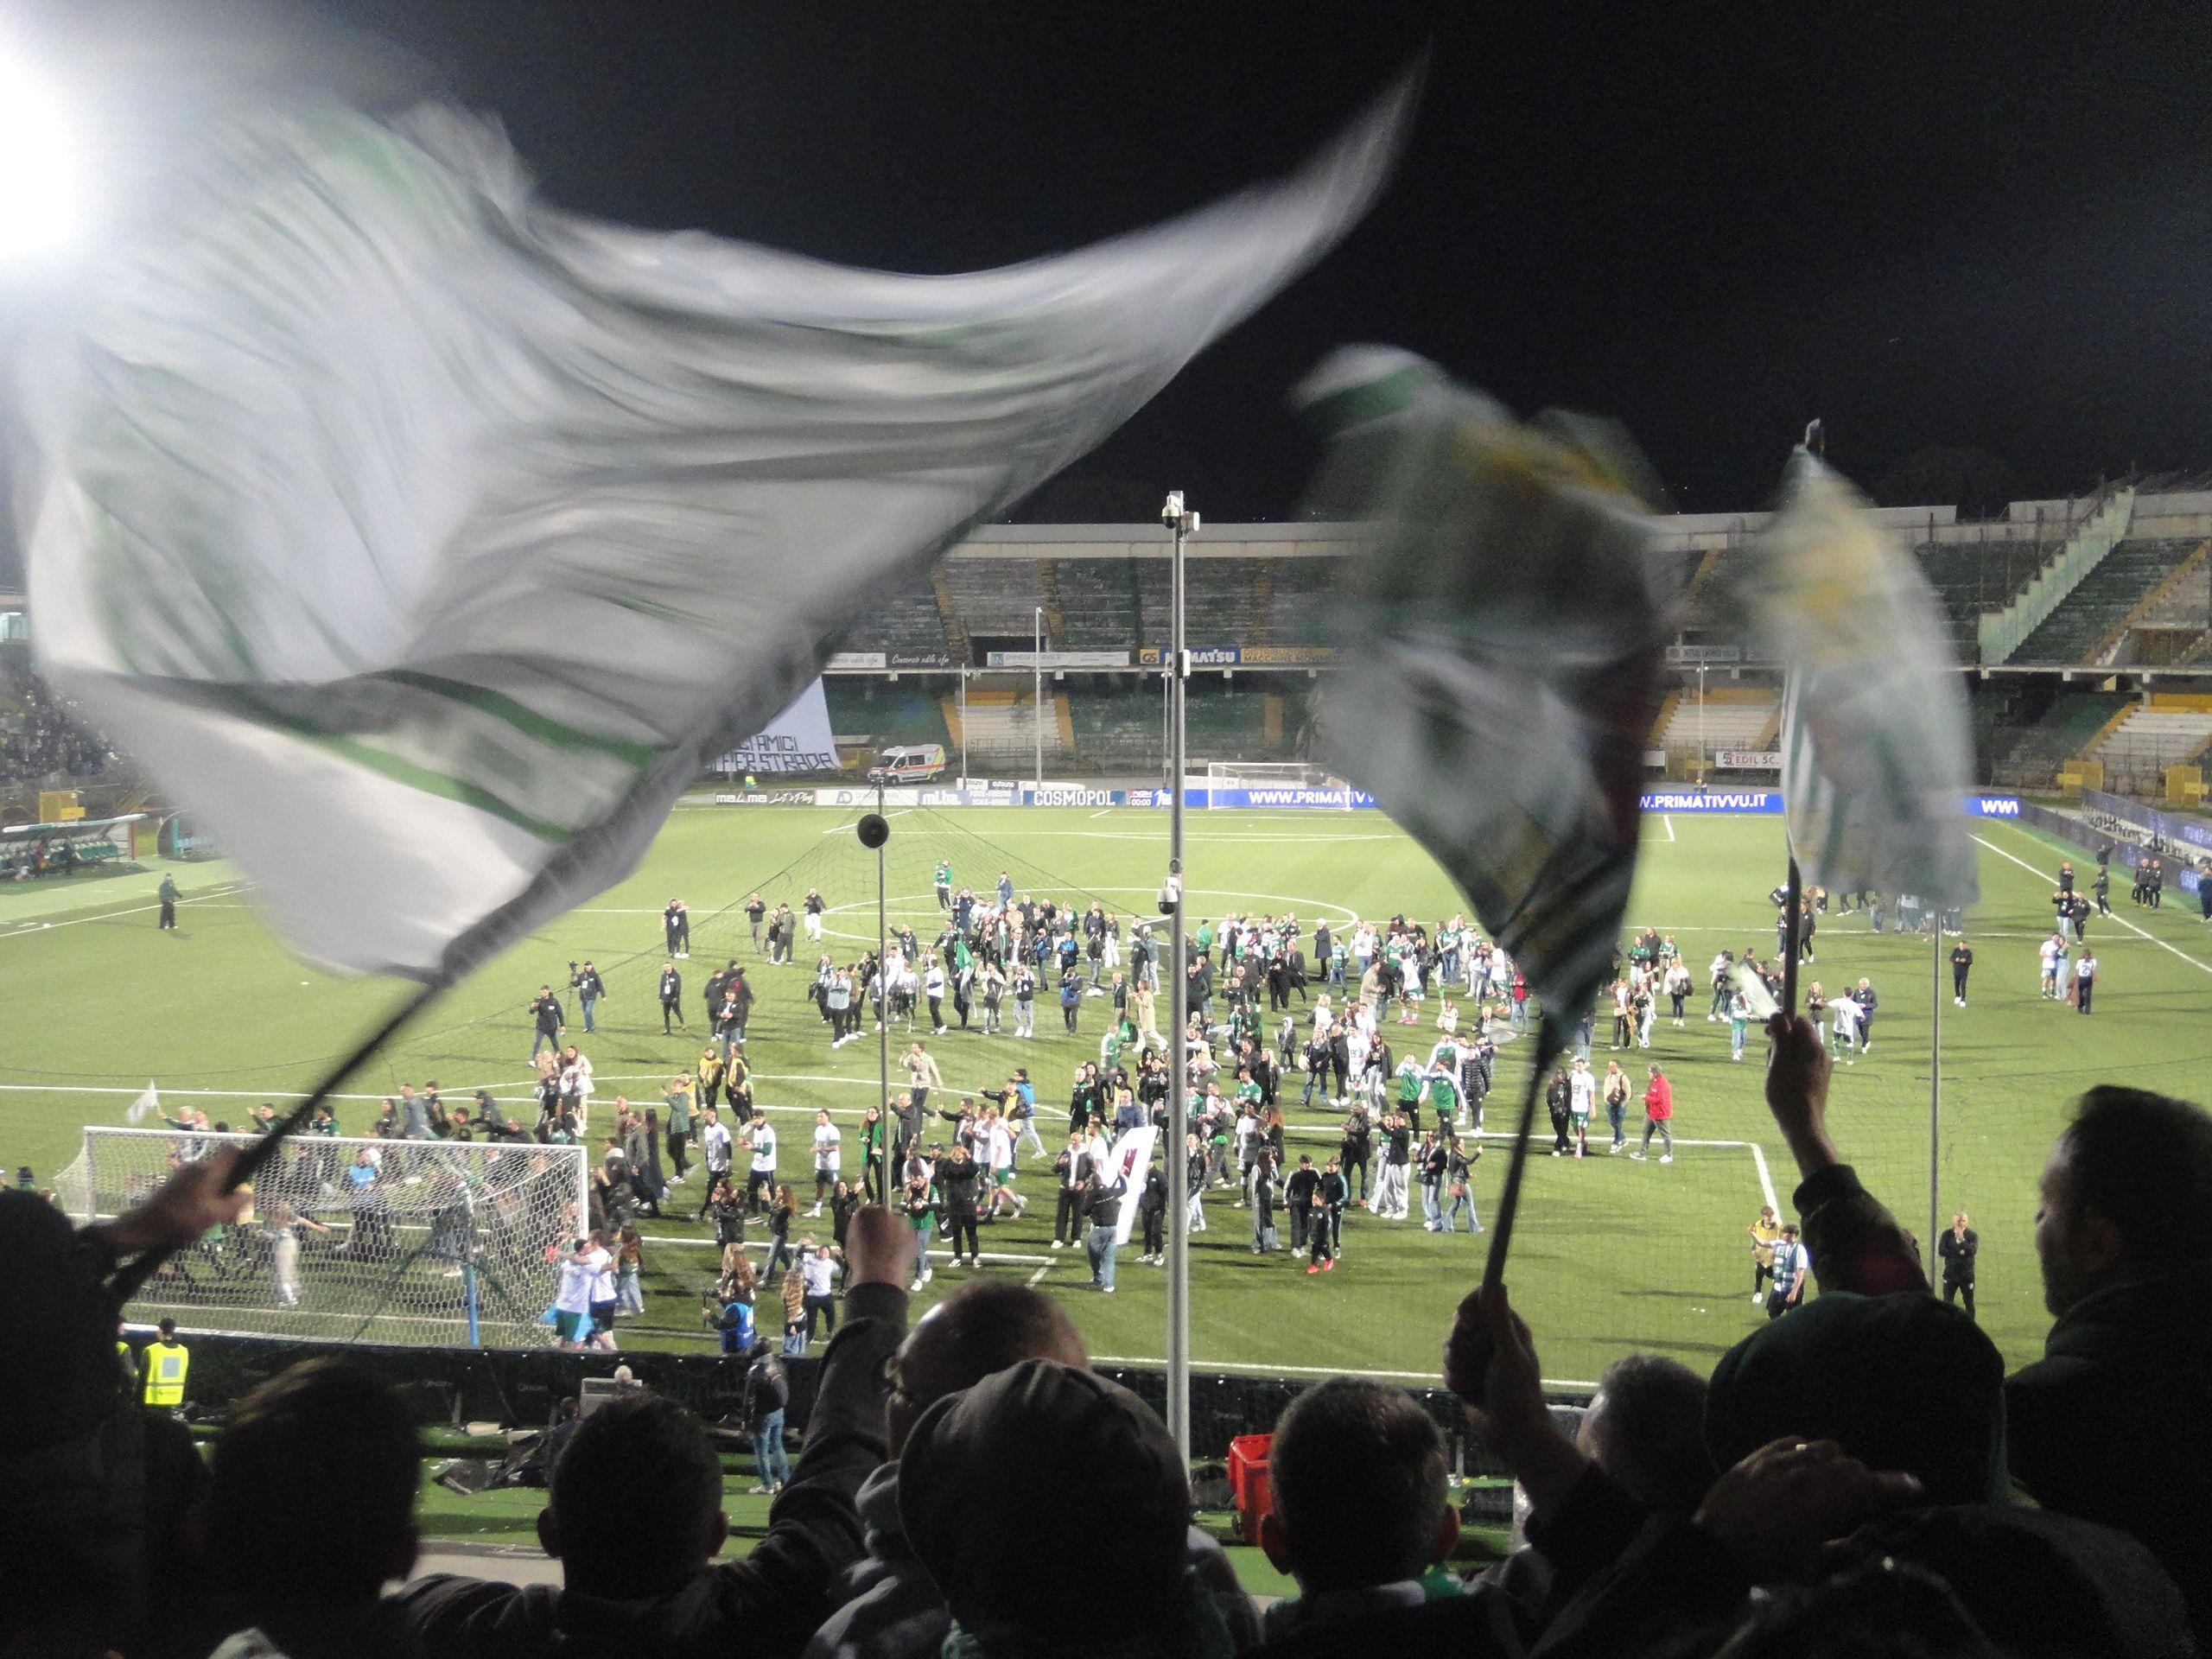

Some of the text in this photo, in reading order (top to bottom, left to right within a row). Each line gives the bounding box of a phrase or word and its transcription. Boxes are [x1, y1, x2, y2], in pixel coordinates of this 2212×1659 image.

[1165, 650, 1236, 664] KMATSU
[757, 735, 798, 752] AMICI
[760, 752, 836, 771] STRADA
[1736, 756, 1758, 765] EDIL
[1033, 791, 1116, 805] COSMOPOL
